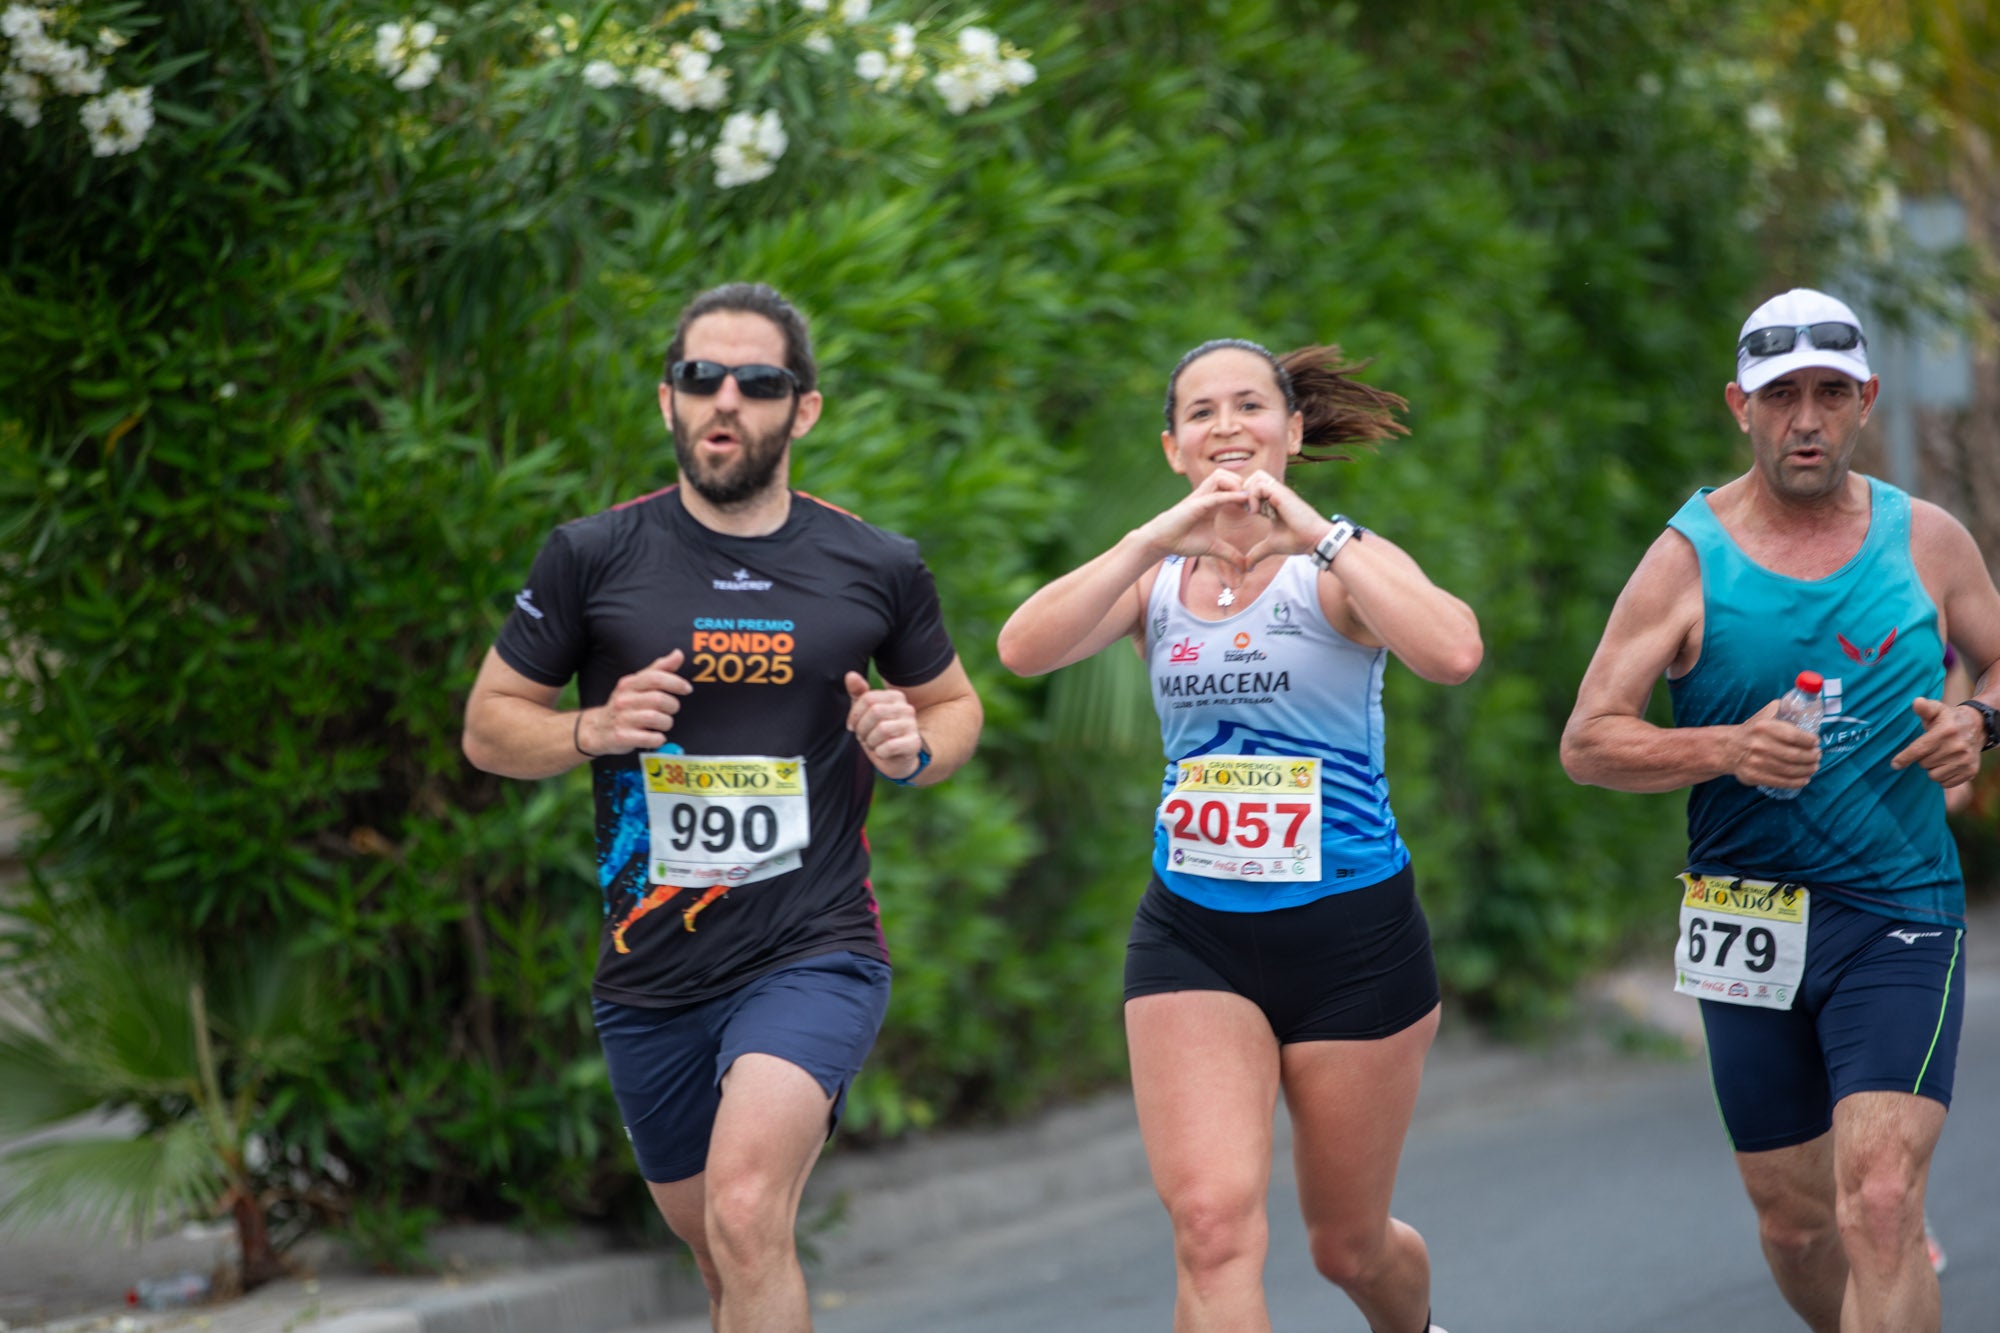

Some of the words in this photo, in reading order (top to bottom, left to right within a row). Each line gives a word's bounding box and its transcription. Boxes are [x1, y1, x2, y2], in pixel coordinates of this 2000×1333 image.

[693, 617, 735, 630] GRAN
[737, 618, 795, 632] PREMIO
[692, 631, 795, 654] FONDO
[692, 653, 794, 685] 2025
[1159, 671, 1291, 697] MARACENA
[664, 763, 684, 785] 38
[687, 764, 717, 772] GRAN
[1202, 769, 1282, 786] FONDO
[1208, 761, 1233, 769] GRAN
[1235, 763, 1274, 771] PREMIO
[685, 772, 770, 789] FONDO
[671, 803, 778, 853] 990
[1165, 799, 1312, 849] 2057
[1704, 888, 1773, 912] FONDO
[1689, 917, 1777, 973] 679
